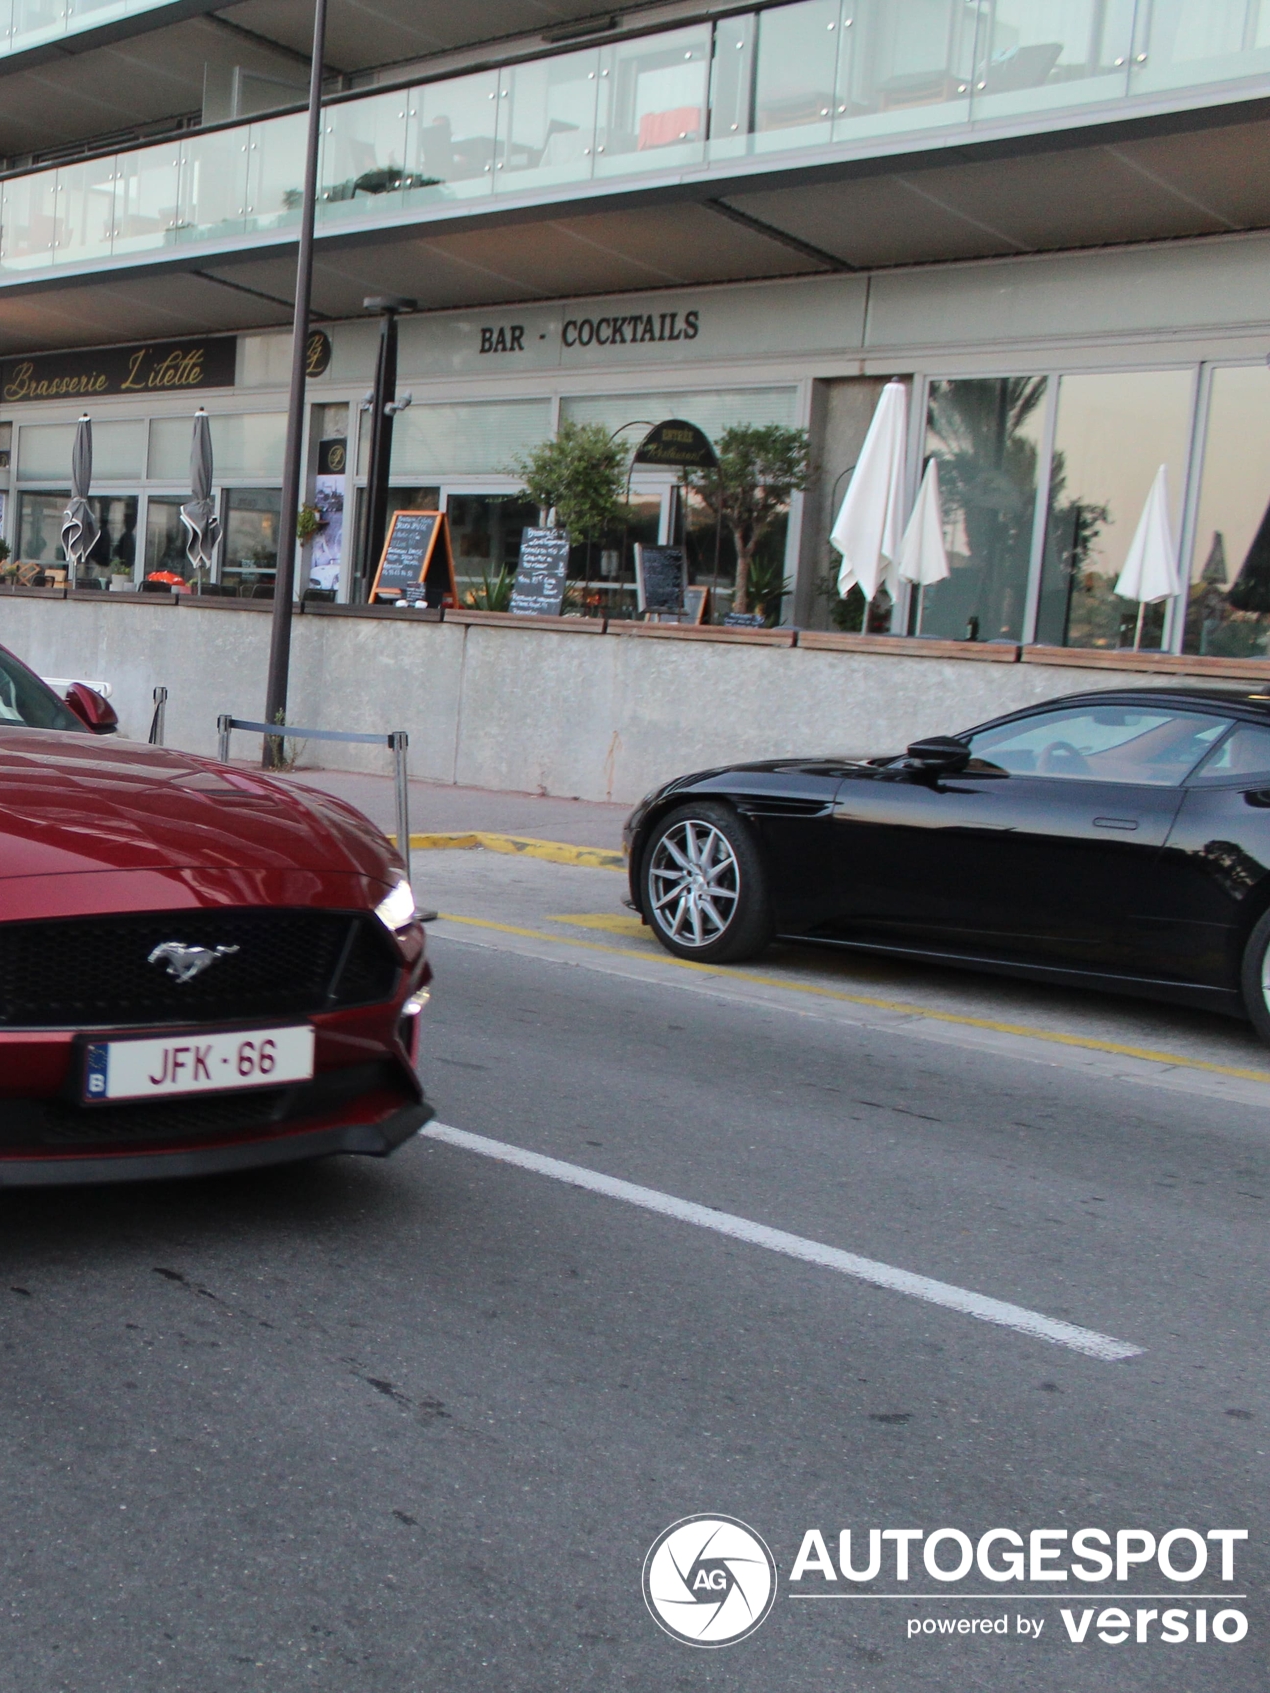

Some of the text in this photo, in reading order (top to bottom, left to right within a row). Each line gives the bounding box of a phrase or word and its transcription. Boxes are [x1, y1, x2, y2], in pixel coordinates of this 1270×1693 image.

[479, 325, 525, 354] BAR
[562, 310, 699, 347] COCKTAILS
[3, 361, 109, 401] Brasserie
[88, 1073, 105, 1093] B
